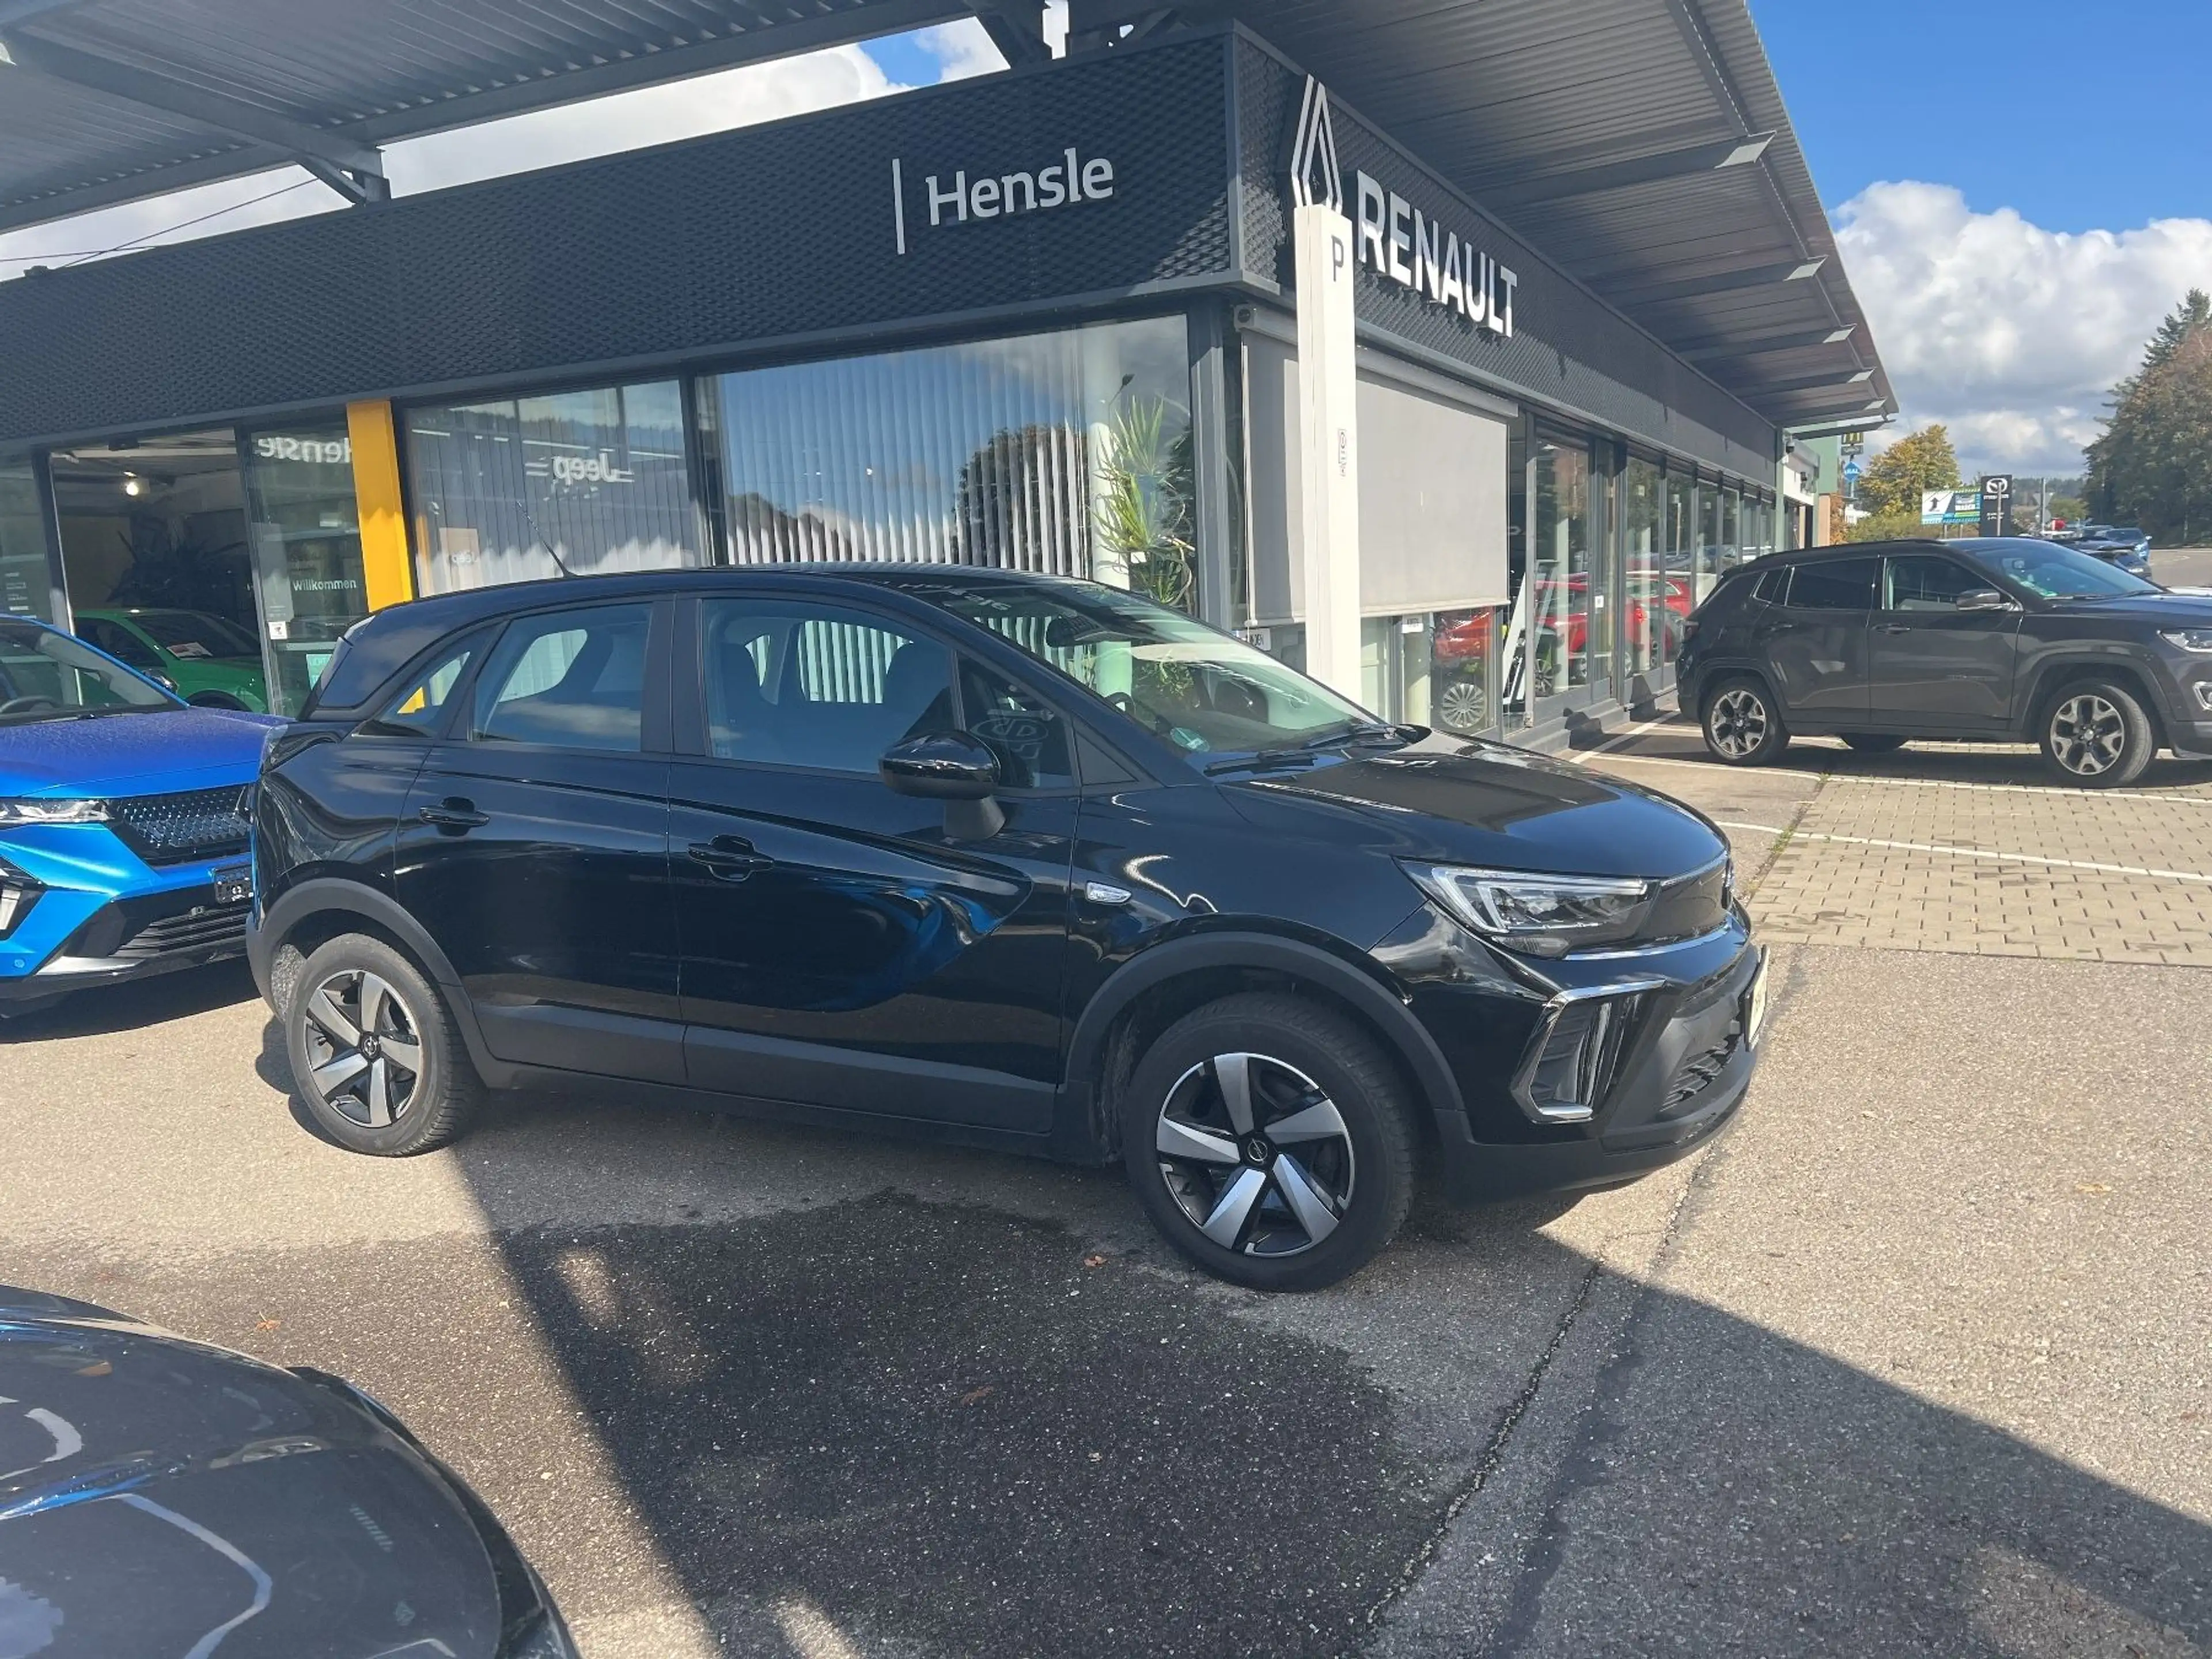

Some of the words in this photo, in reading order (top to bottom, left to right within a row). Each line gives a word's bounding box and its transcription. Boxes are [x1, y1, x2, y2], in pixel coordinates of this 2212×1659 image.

[925, 147, 1113, 226] Hensle
[1331, 234, 1344, 282] P
[1357, 170, 1517, 338] RENAULT
